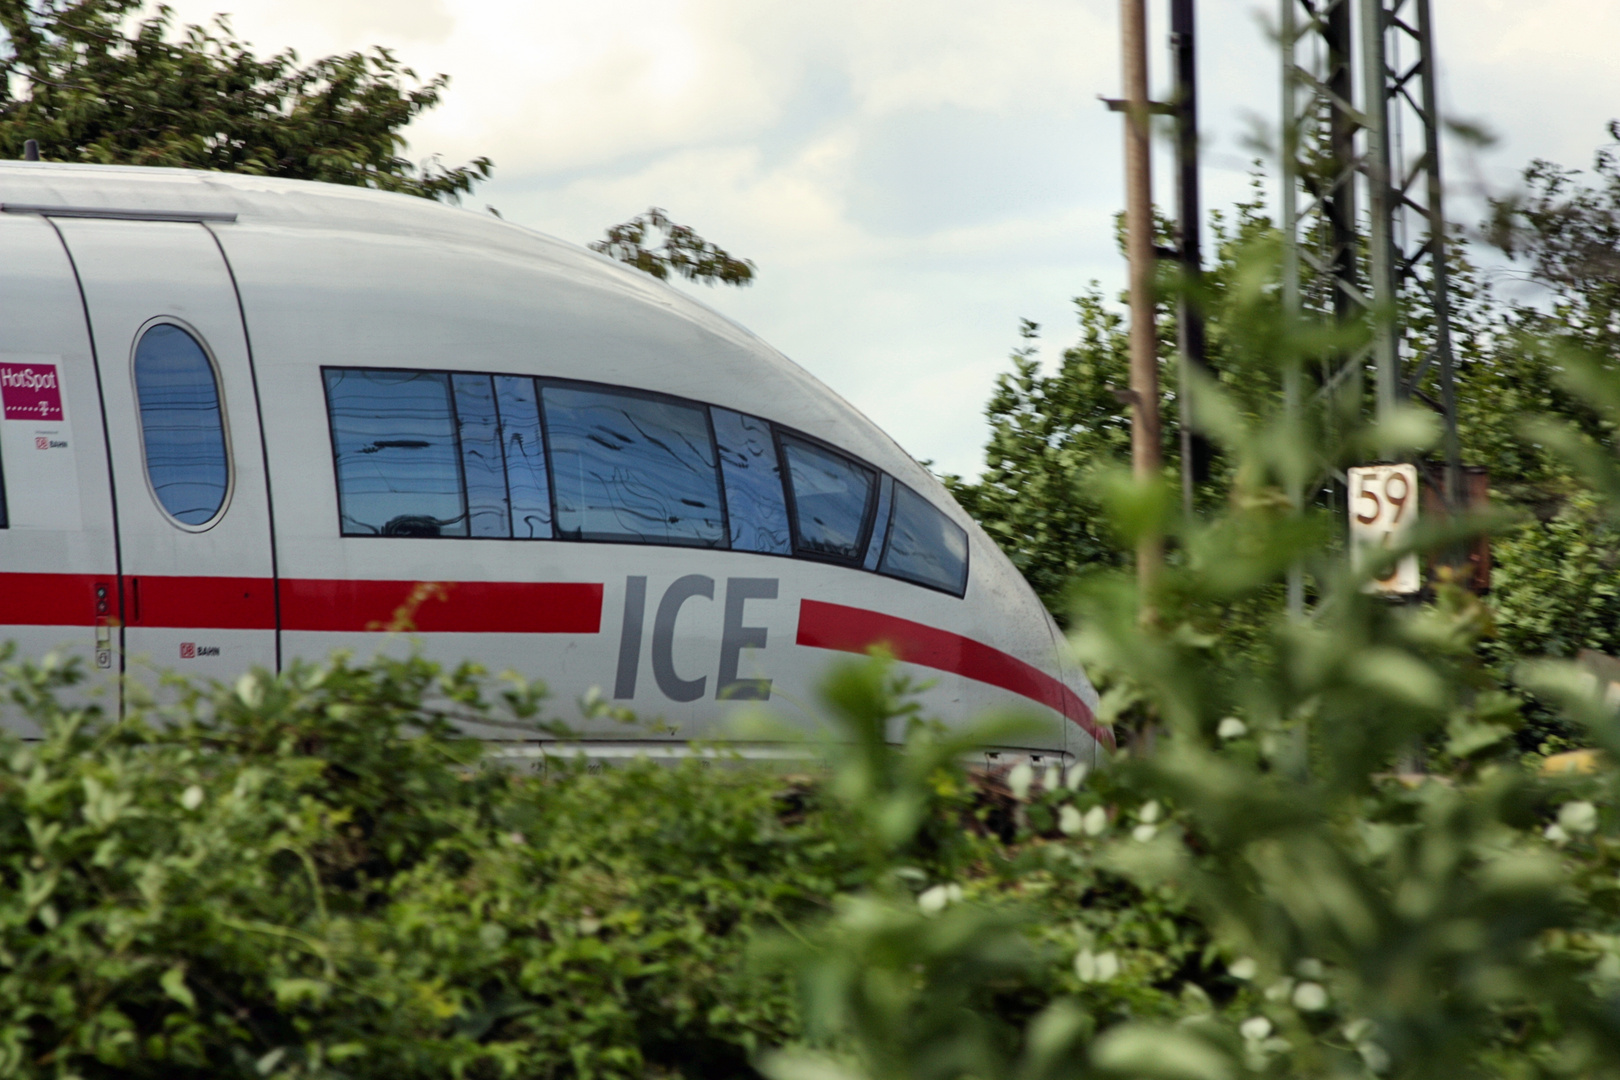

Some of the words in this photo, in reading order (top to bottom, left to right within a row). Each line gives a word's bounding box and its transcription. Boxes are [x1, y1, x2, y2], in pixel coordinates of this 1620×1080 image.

[1, 368, 56, 392] HotSpot
[1357, 472, 1408, 525] 59
[197, 646, 220, 656] BAHN
[613, 574, 779, 702] ICE
